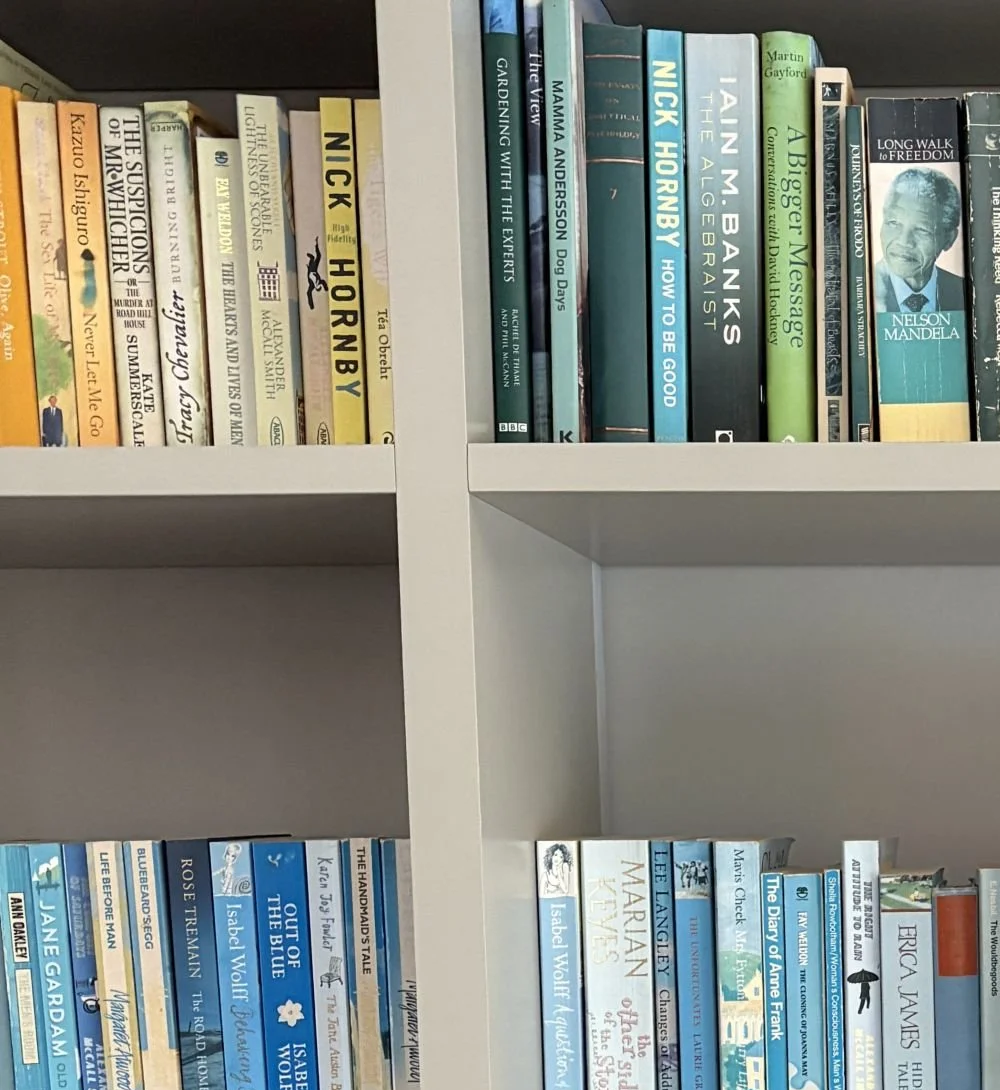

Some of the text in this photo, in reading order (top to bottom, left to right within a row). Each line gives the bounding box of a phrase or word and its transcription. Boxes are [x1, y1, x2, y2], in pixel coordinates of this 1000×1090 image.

[529, 50, 544, 126] The View
[244, 106, 263, 251] LIGHTNESS OF SCONES
[496, 58, 515, 283] GARDENING WITH THE EXPERTS
[552, 80, 569, 311] MAMMA ANDERSSON Dog Days
[325, 132, 361, 397] NICK HORNBY
[653, 60, 680, 407] NICK HORNBY HOW TO BE GOOD
[779, 126, 809, 348] A Bigger Message
[69, 113, 103, 437] Kazuo Ishiguro Never Let Me Go
[222, 262, 235, 285] THE
[223, 289, 237, 335] HEARTS
[225, 338, 239, 363] AND
[273, 319, 285, 391] ALEXANDER
[377, 309, 390, 380] Téa Obreht
[511, 309, 521, 386] RACHEL DE THAME
[884, 327, 960, 339] MANDELA
[891, 314, 951, 326] NELSON
[161, 290, 199, 445] Tracy Chevalier
[226, 366, 241, 399] LIVES
[229, 402, 241, 417] OF
[11, 897, 27, 958] ANN OAKLEY
[39, 900, 60, 956] JANE
[100, 852, 116, 949] LIFE BEFORE MAN
[267, 894, 283, 978] THE BLUE
[283, 903, 300, 968] OUT OF
[357, 847, 372, 974] THE HANDMAID'S TALE
[767, 876, 784, 1041] The Diary of Anne Frank
[897, 925, 919, 1049] ERICA JAMES
[45, 961, 67, 1057] GARDAM
[57, 1063, 67, 1088] OLD
